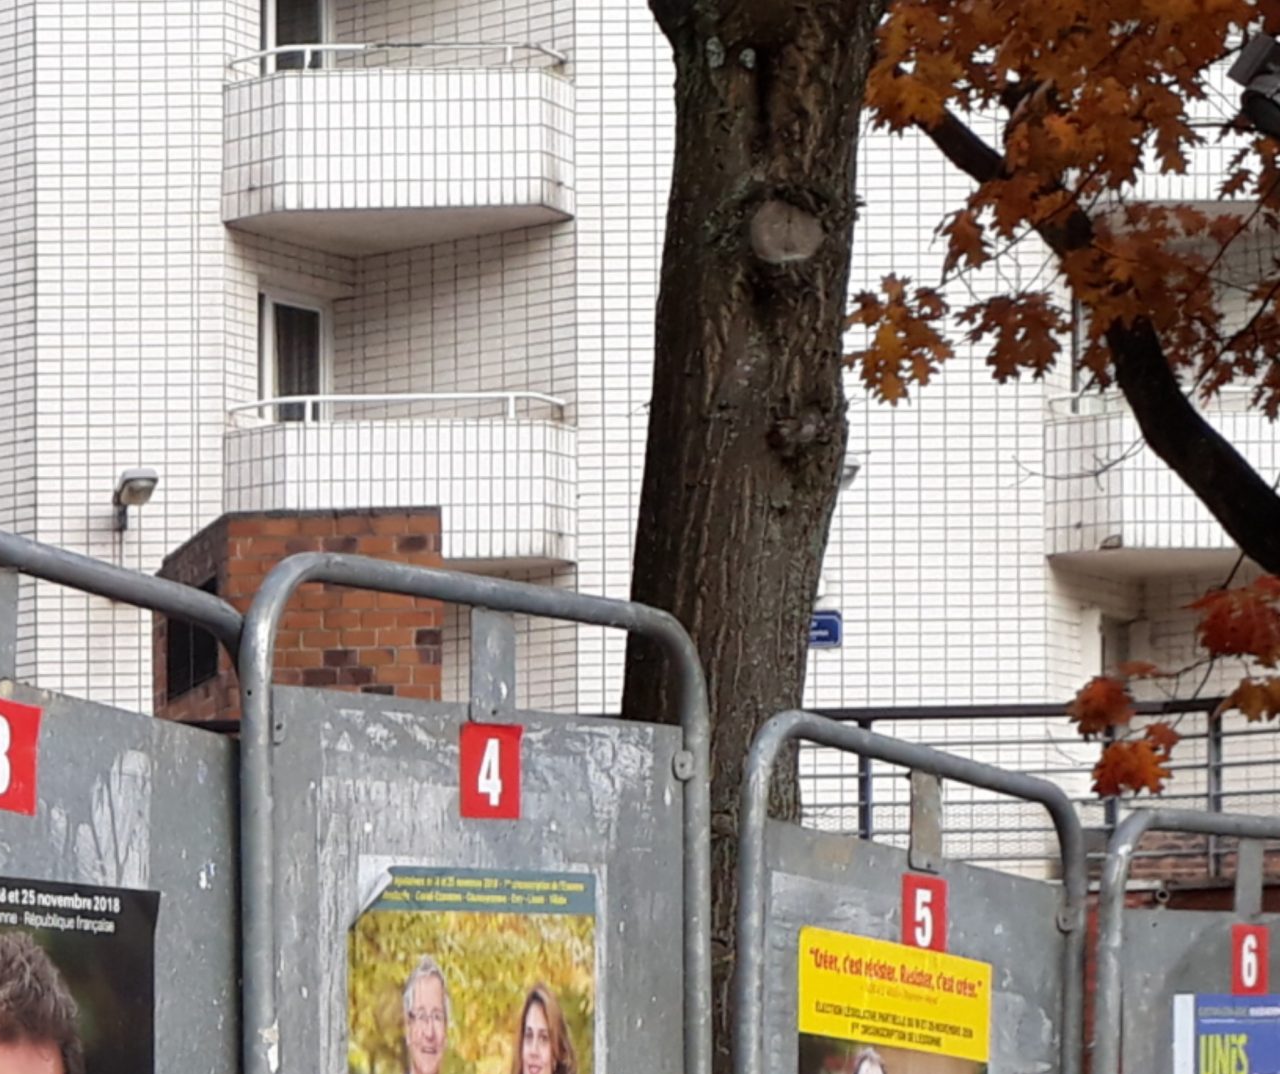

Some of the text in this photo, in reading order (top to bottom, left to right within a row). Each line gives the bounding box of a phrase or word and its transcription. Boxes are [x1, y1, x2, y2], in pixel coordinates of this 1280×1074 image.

[477, 738, 503, 807] 4
[7, 888, 19, 904] et
[21, 889, 36, 905] 25
[37, 893, 92, 911] novembre
[93, 896, 120, 913] 2018
[915, 888, 933, 948] 5
[1241, 934, 1258, 987] 6
